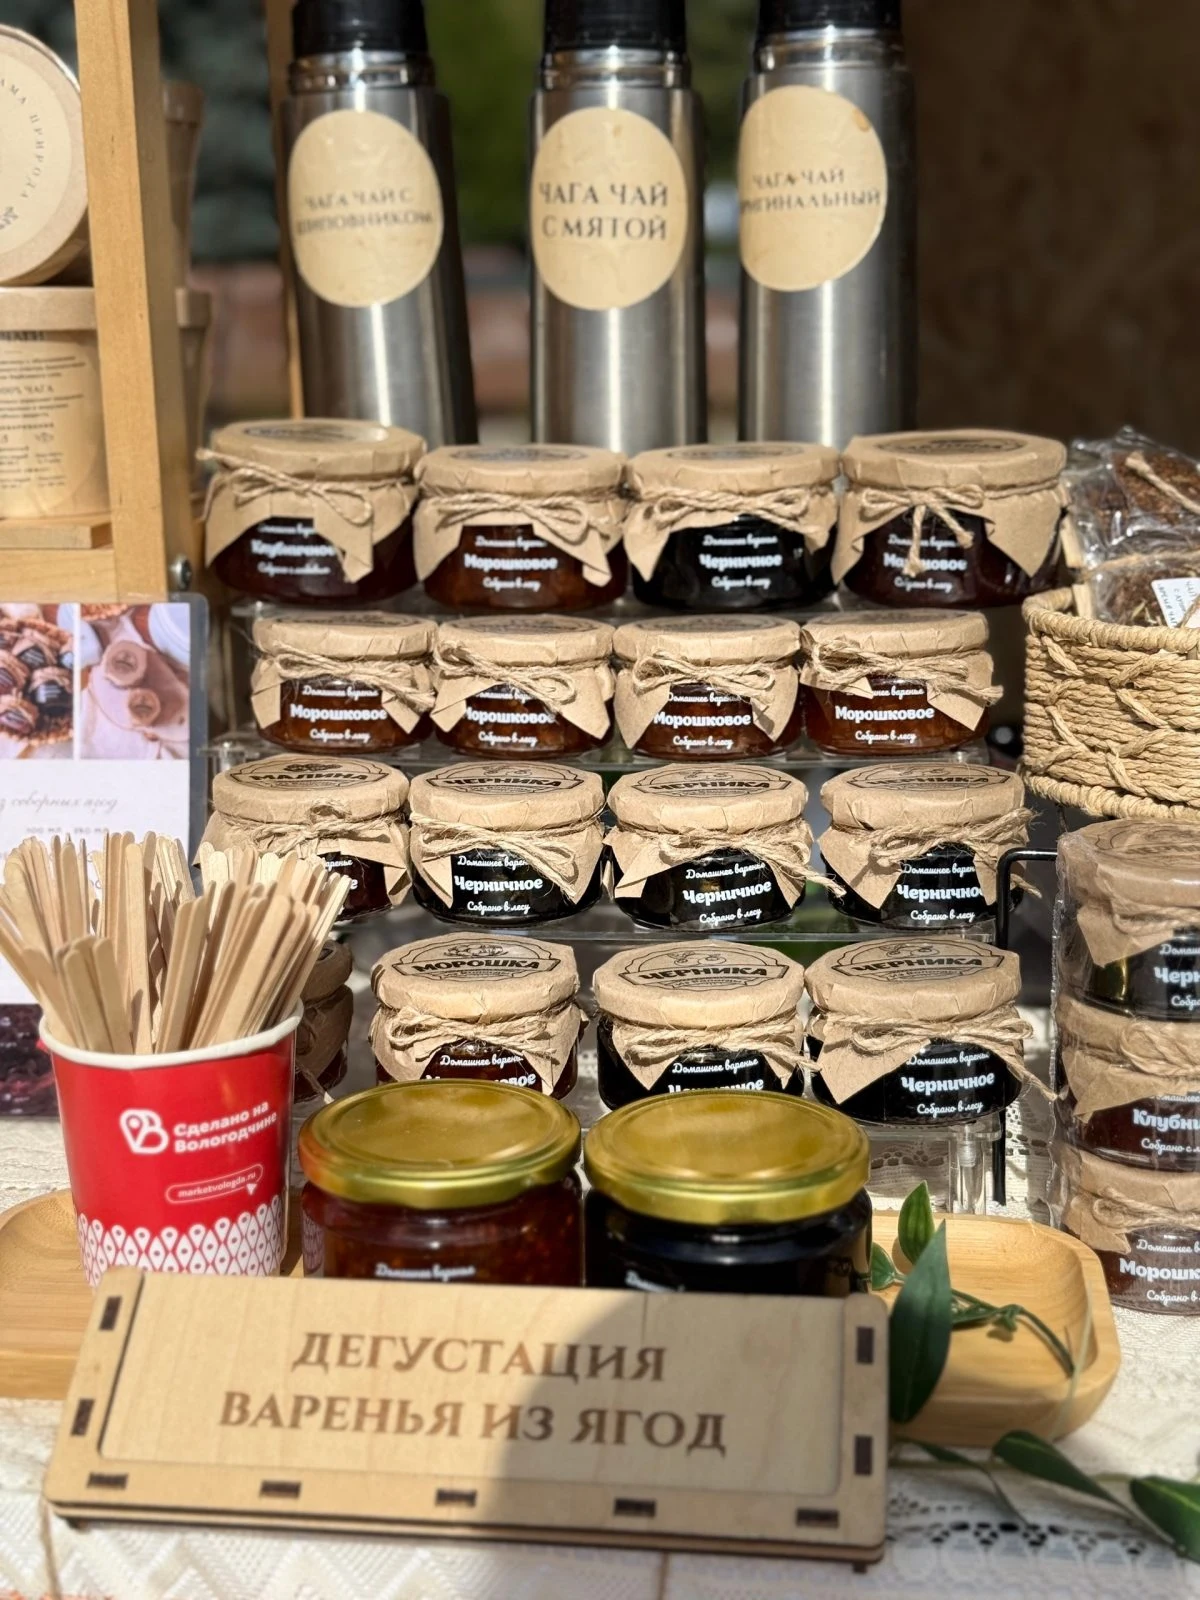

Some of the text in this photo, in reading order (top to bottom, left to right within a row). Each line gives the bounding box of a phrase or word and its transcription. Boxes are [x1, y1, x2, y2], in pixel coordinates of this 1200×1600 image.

[801, 164, 845, 184] ЧАЙ
[304, 192, 348, 210] ЧАГА
[353, 188, 395, 206] ЧАЙ
[538, 181, 668, 207] ЧАГА ЧАЙ
[542, 214, 667, 240] С МЯТОЙ
[464, 553, 558, 572] Морошковое
[699, 553, 783, 572] Черничное
[290, 703, 387, 722] Морошковое
[653, 711, 751, 729] Морошковое
[835, 705, 935, 723] Морошковое
[673, 735, 706, 750] Собрано
[855, 729, 917, 744] Собрано в лесу
[250, 773, 369, 781] МАЛИНА
[444, 777, 562, 787] ЧЕРНИКА
[648, 780, 771, 790] ЧЕРНИКА
[867, 776, 989, 785] ЧЕРНИКА
[457, 855, 528, 870] Домашнее варен
[685, 862, 766, 880] Домашнее варенье
[902, 863, 951, 874] Домашнее
[454, 876, 544, 895] Черничное
[682, 880, 772, 906] Черничное
[896, 884, 984, 903] Чернично
[467, 901, 531, 915] Собрано в лесу
[910, 909, 975, 925] Собрано в лесу
[699, 908, 762, 927] Собрано в лесу
[413, 959, 540, 973] МОРОШКА
[639, 966, 768, 979] ЧЕРНИКА
[852, 958, 982, 971] ЧЕРНИКА
[439, 1055, 491, 1066] Домашнее
[672, 1058, 759, 1074] Домашнее варенье
[906, 1055, 958, 1066] Домашнее
[900, 1073, 995, 1096] Черничное
[916, 1100, 984, 1118] Собрано в лесу
[173, 1101, 270, 1138] Сделано на
[174, 1111, 278, 1154] Вологодчине
[1141, 1137, 1185, 1156] Собрано
[177, 1171, 257, 1199] marketvologda.ru
[1136, 1239, 1193, 1253] Домашнее
[1146, 1289, 1199, 1308] Собрано в
[291, 1331, 667, 1384] ДЕГУСТАЦИЯ
[218, 1390, 728, 1457] ВАРЕНЬЯ ИЗ ЯГОД
